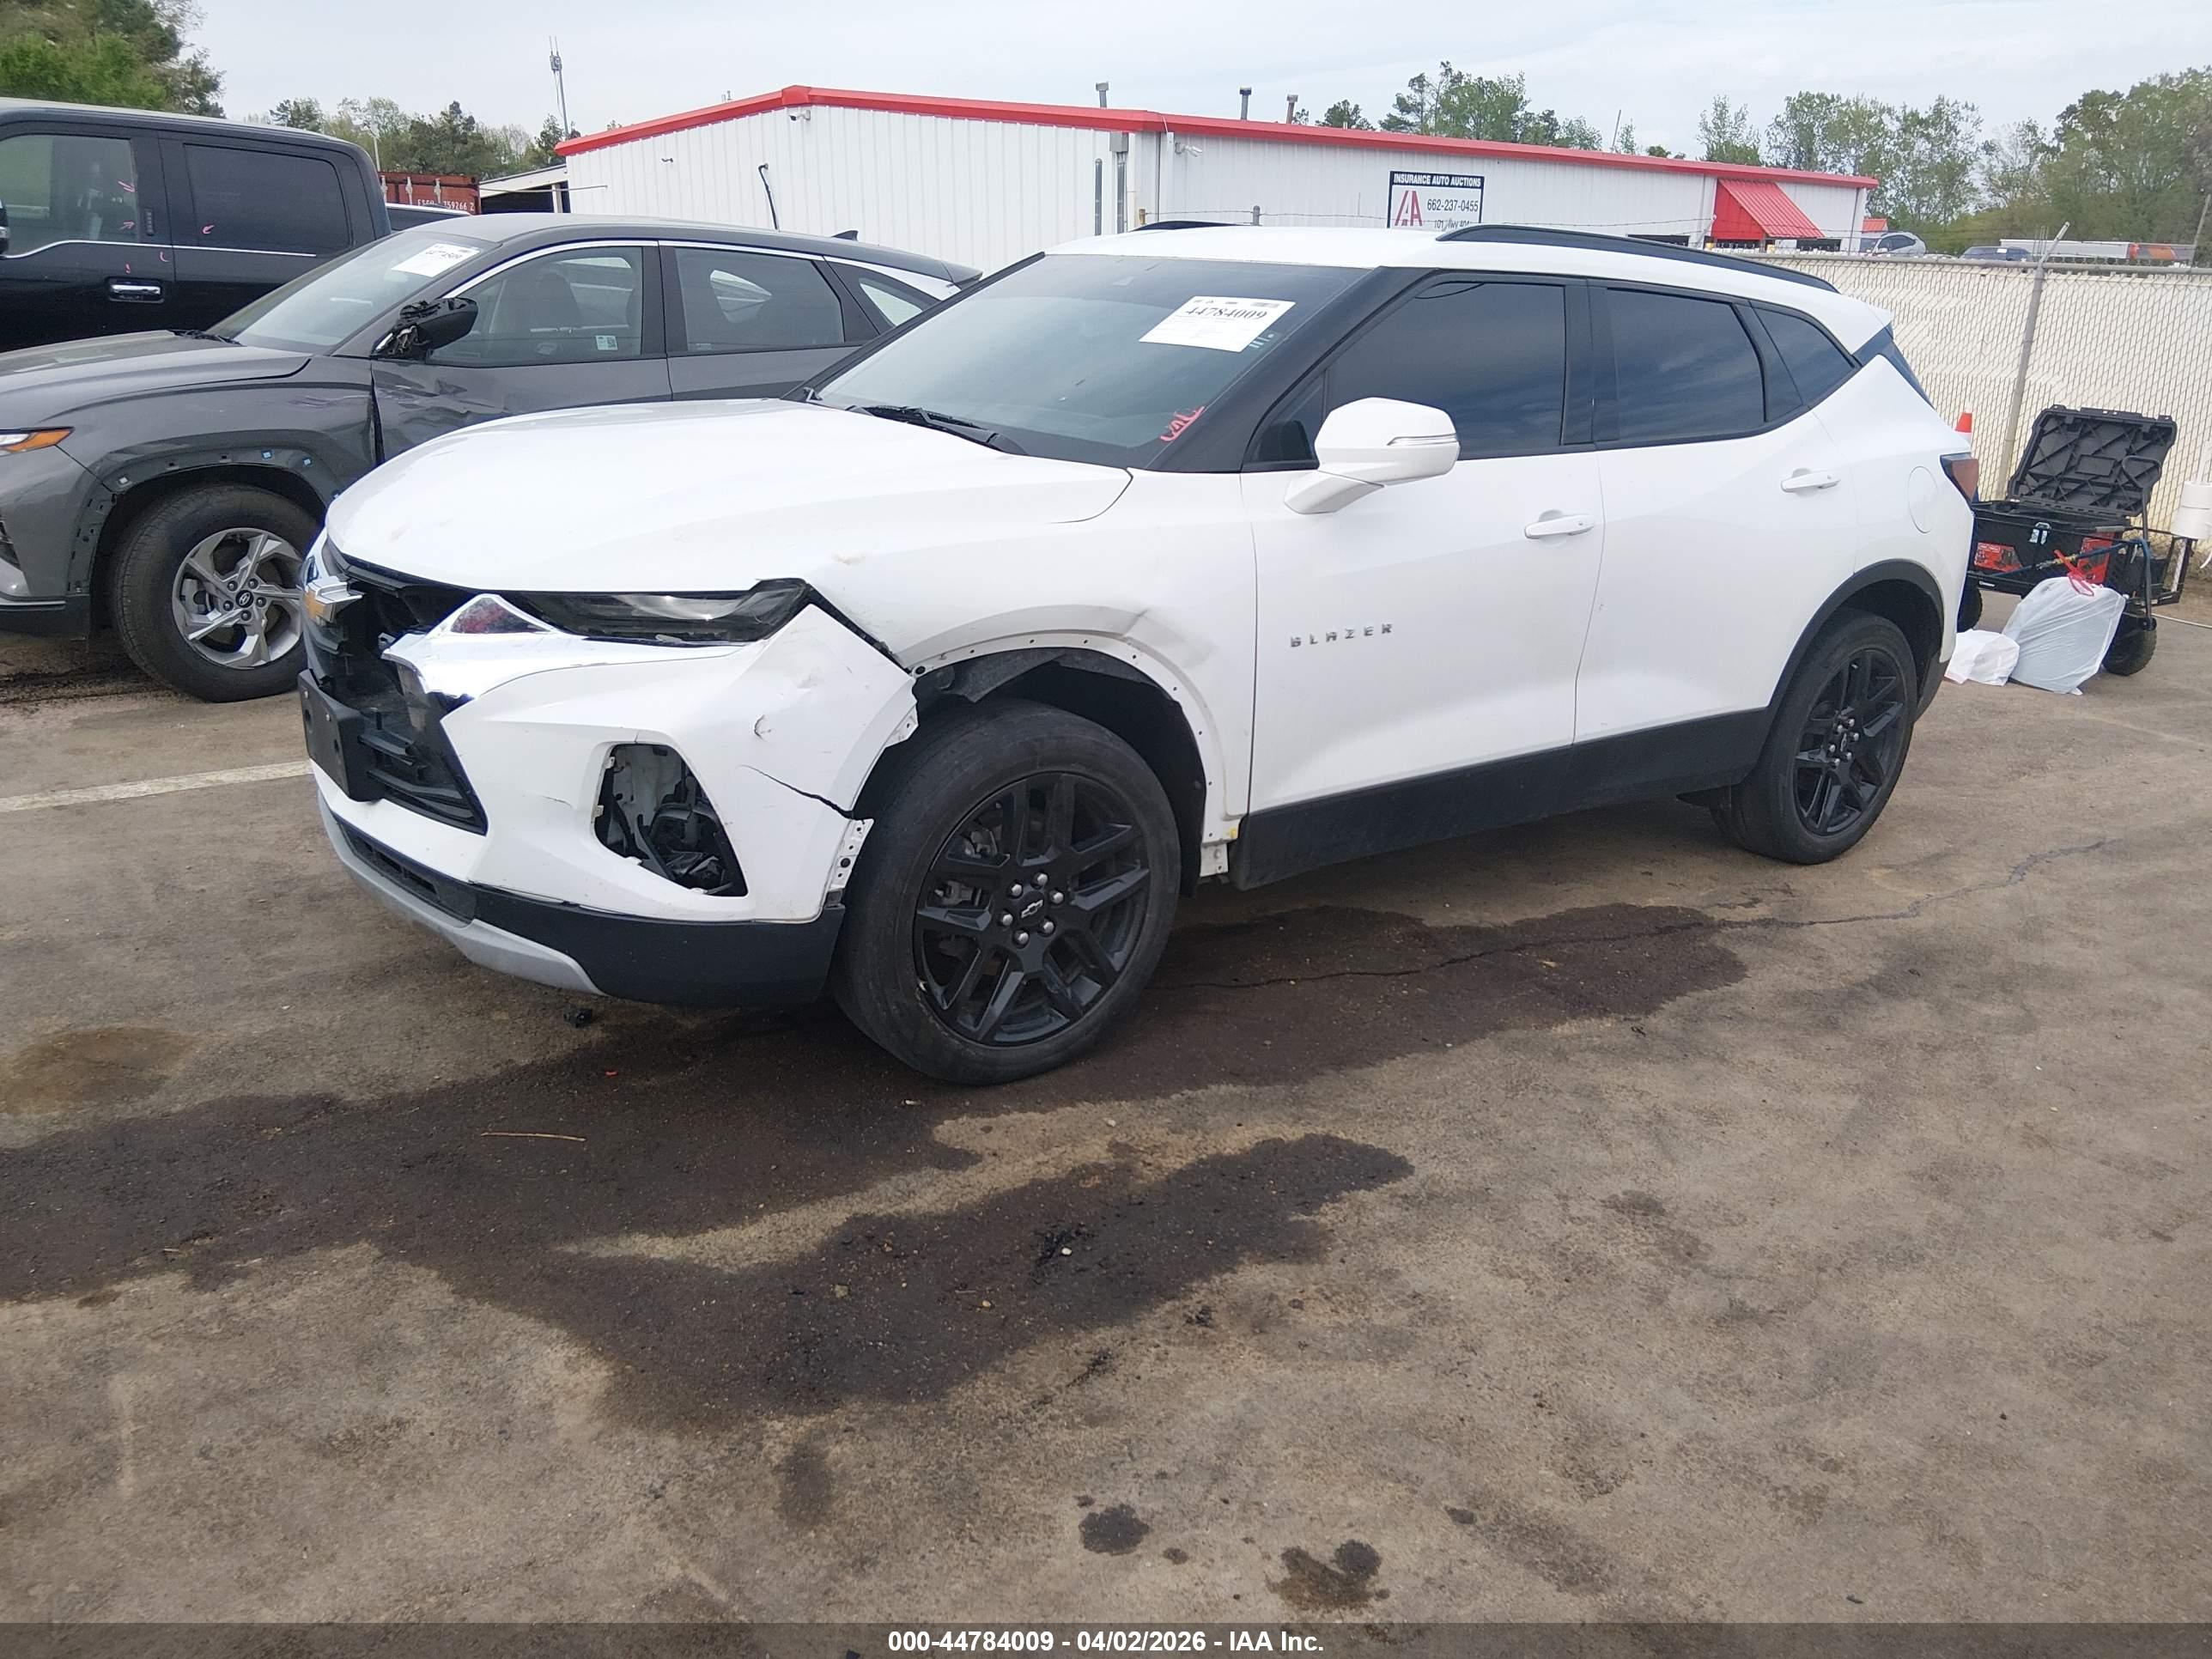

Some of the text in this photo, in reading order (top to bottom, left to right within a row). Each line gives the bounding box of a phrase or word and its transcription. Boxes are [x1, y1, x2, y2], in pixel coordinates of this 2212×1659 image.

[1394, 173, 1481, 187] INSURANCE AUTO AUCTIONS
[1427, 198, 1479, 212] 662-237-0455
[1185, 307, 1267, 319] 44784009
[1290, 623, 1393, 647] BLAZER
